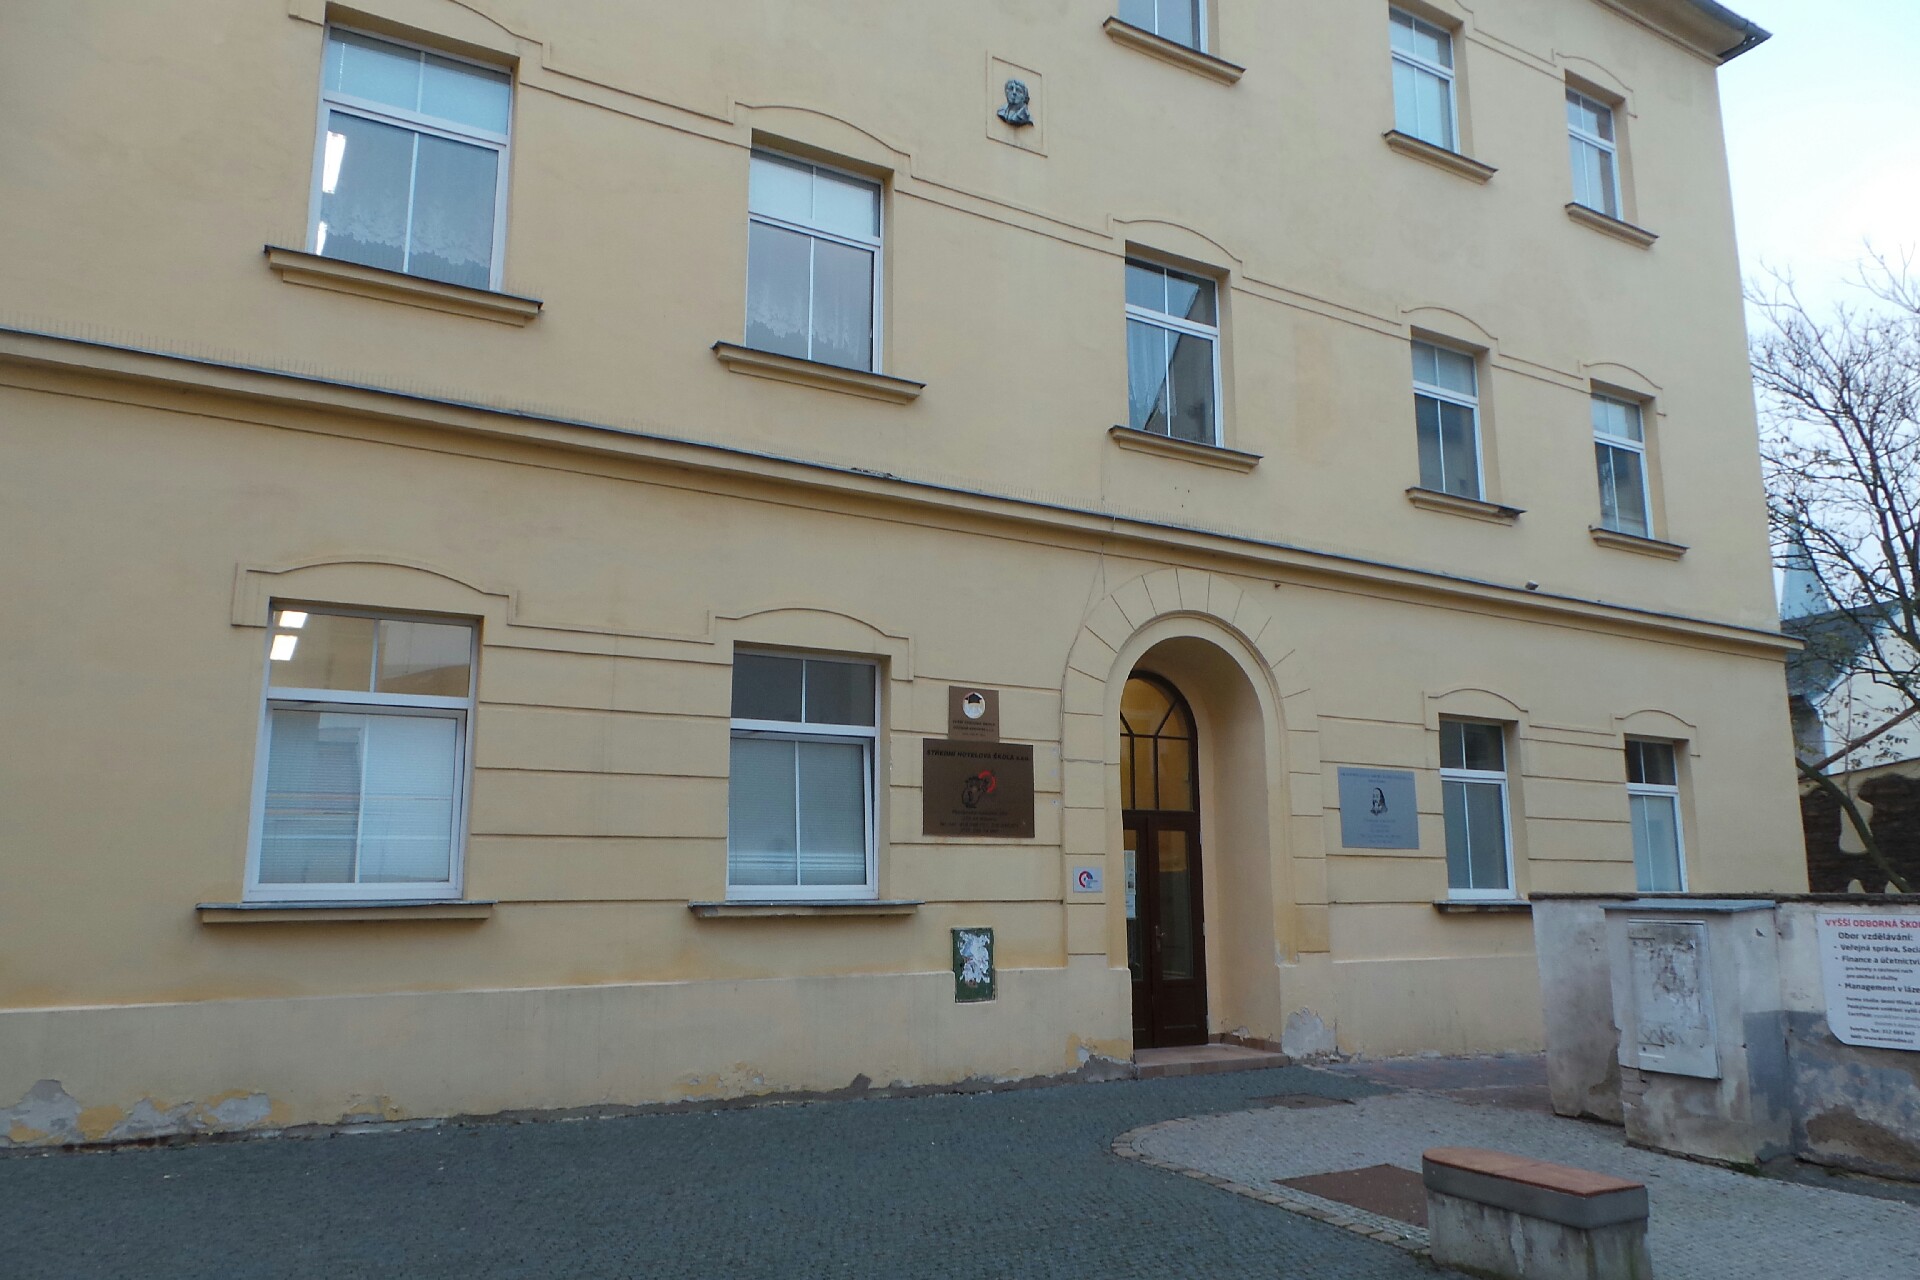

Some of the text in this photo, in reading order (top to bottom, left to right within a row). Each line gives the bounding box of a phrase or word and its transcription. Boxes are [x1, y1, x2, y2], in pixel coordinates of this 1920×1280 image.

[1853, 919, 1898, 928] ODBORNÁ
[1838, 931, 1913, 941] Obor vzdělávání:
[1840, 944, 1870, 953] Veřejná
[1841, 955, 1872, 963] Finance
[1844, 982, 1896, 992] Management
